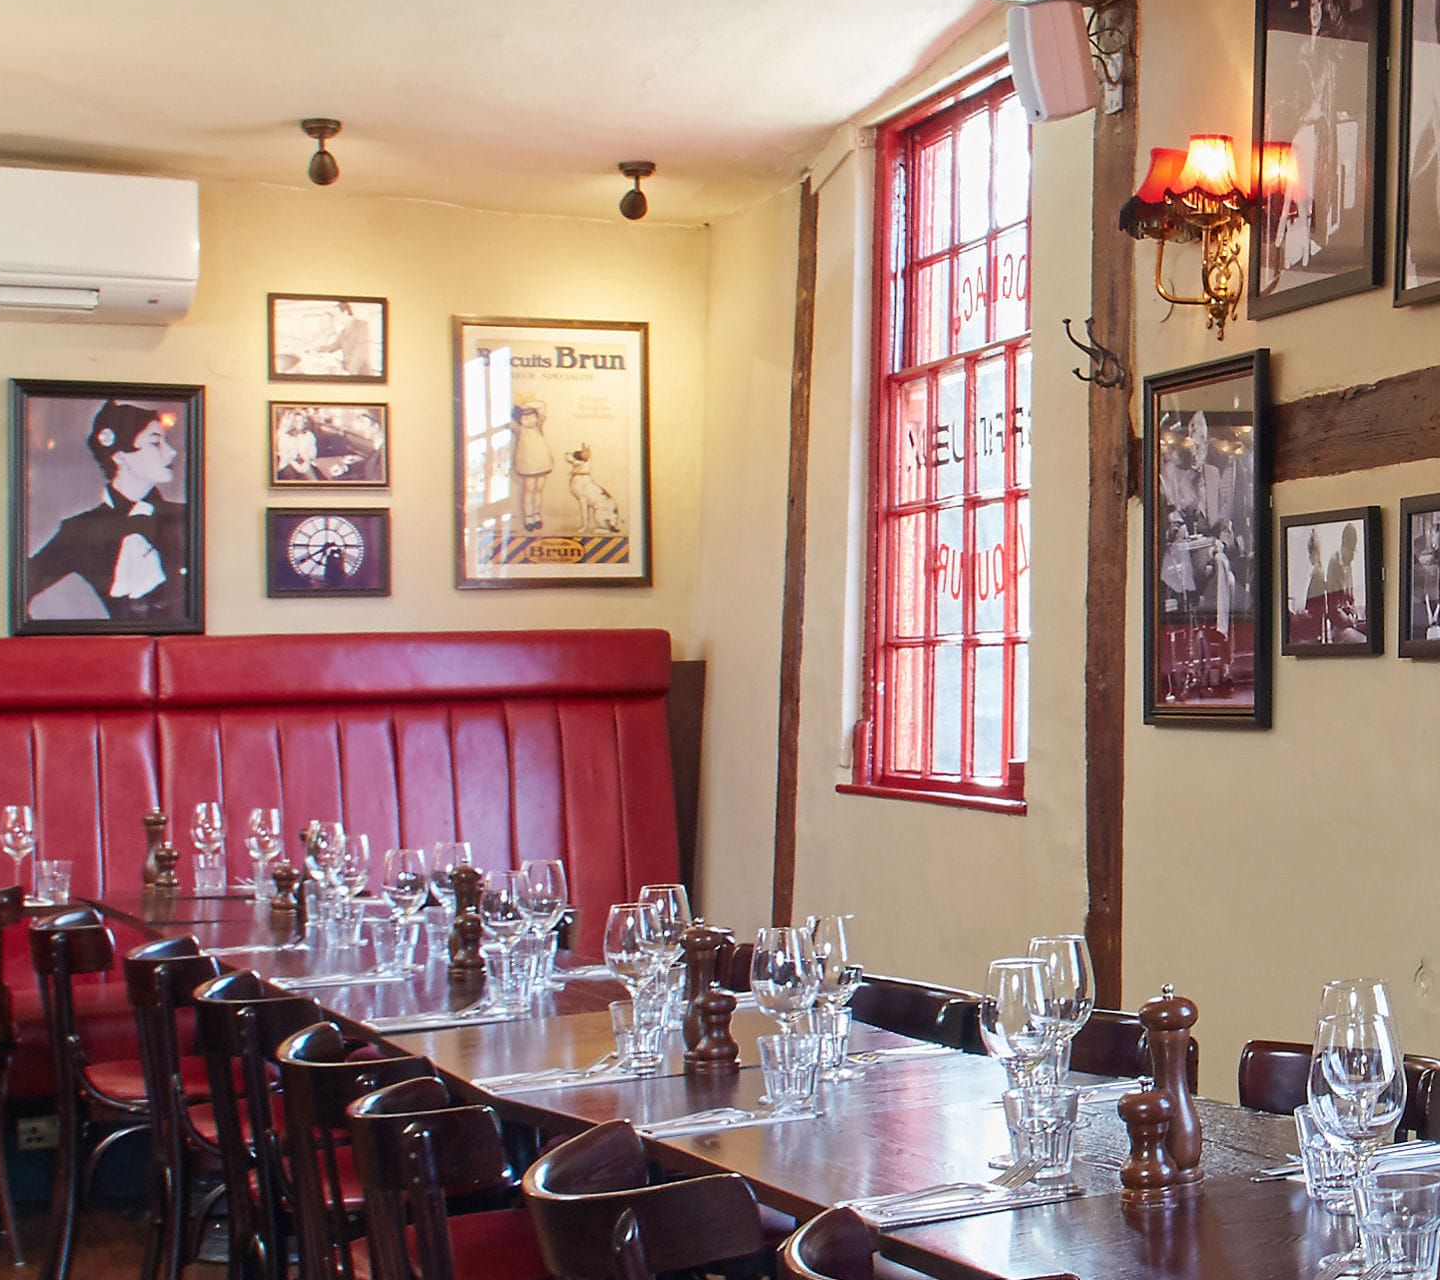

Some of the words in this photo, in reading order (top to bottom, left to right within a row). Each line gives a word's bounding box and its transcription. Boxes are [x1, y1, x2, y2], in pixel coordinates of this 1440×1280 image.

[477, 347, 552, 369] Bcuits
[554, 346, 627, 371] Brun
[529, 545, 582, 557] Brun
